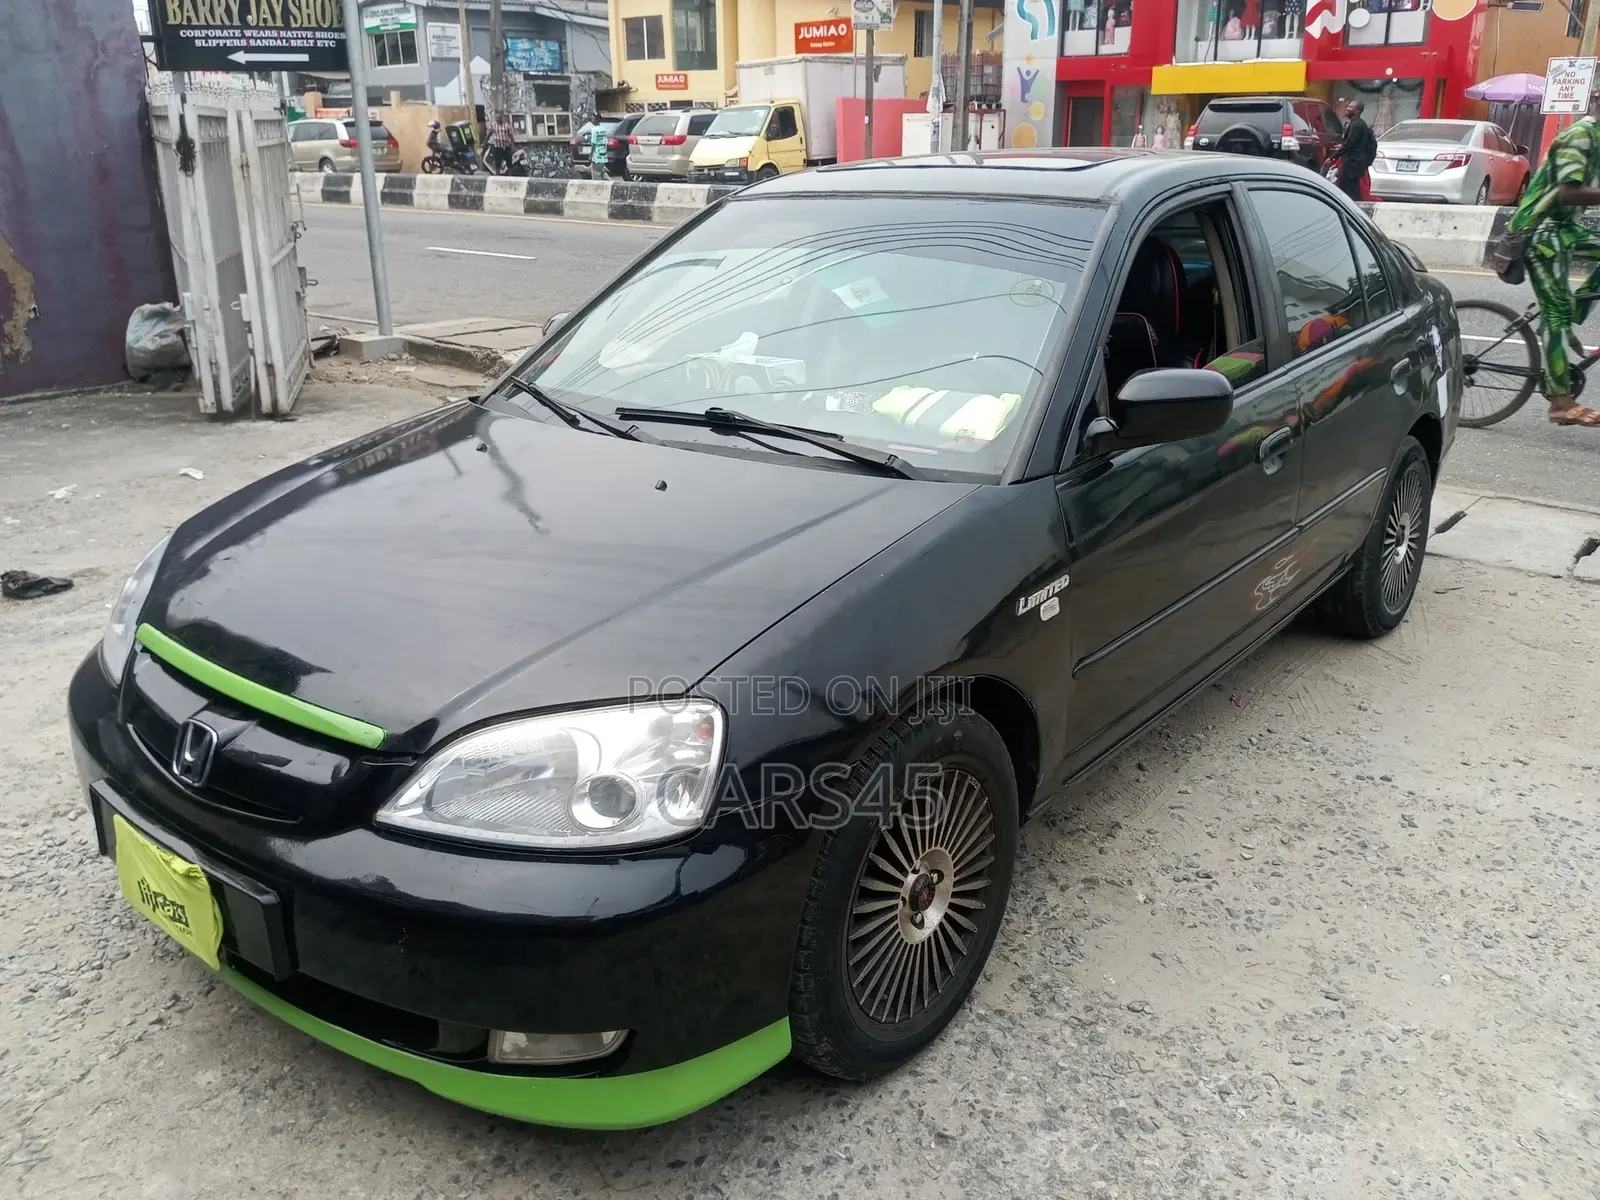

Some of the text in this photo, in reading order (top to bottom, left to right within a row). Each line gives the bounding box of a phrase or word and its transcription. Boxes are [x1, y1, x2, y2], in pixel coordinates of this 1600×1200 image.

[166, 0, 242, 26] BARRY
[246, 0, 285, 27] JAY
[179, 29, 347, 40] CORPORATE WEARS NATIVE SHOES
[194, 39, 336, 48] SLIPPERS SANDAL BELT ETC
